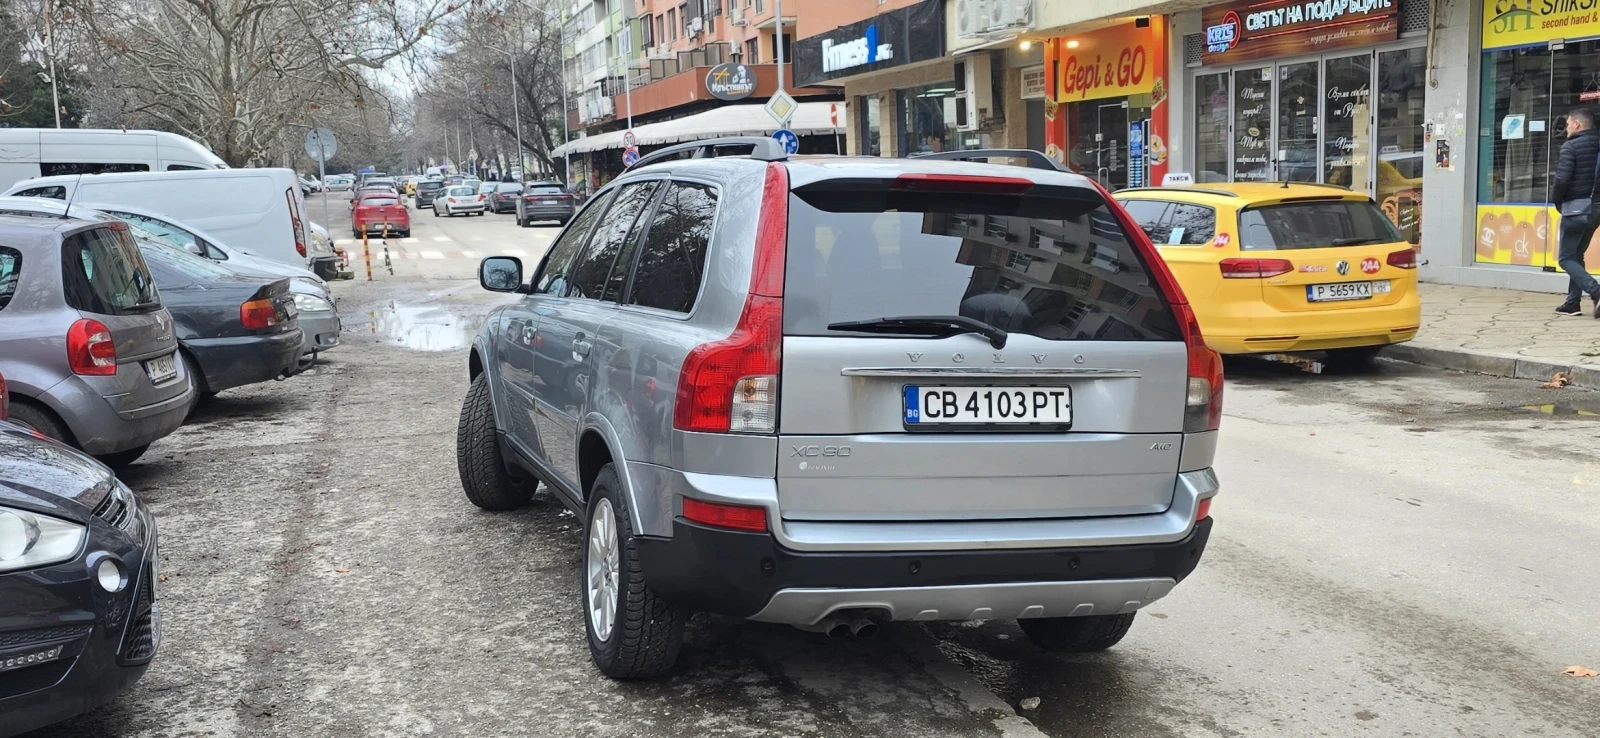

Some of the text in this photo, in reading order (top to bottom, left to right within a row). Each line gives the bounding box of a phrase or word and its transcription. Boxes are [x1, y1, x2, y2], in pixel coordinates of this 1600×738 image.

[1246, 9, 1285, 31] СВЕТЪТ
[1286, 7, 1303, 25] НА
[1541, 11, 1598, 29] second hand &
[1208, 25, 1235, 43] KRIS
[1208, 43, 1230, 53] design
[1064, 45, 1146, 98] Gepi & GO
[625, 135, 633, 146] 30
[1361, 260, 1380, 271] 244
[907, 353, 1085, 364] VOLVO
[924, 391, 1065, 418] CB 4103 PT
[907, 409, 919, 418] BG
